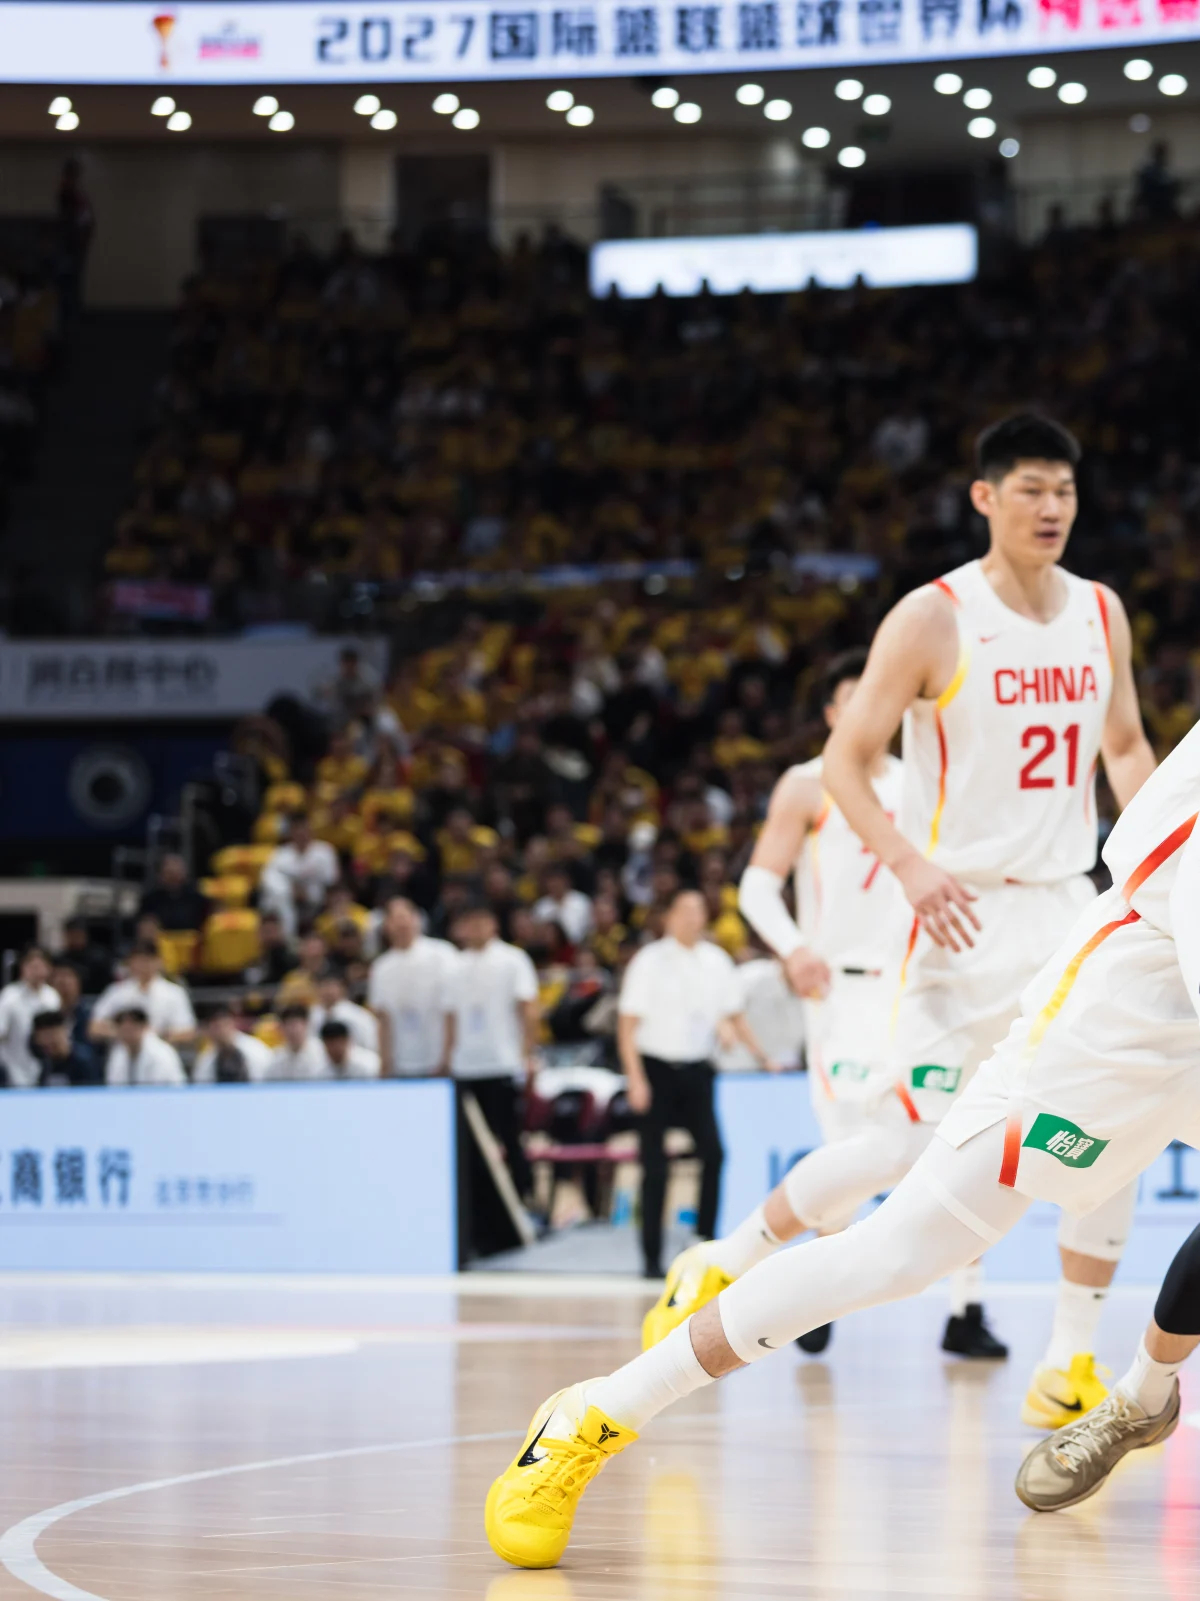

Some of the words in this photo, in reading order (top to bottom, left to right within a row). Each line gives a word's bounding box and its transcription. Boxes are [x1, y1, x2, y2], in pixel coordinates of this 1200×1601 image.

[994, 665, 1099, 705] CHINA
[1019, 723, 1081, 791] 21
[0, 1146, 132, 1207] 商银行
